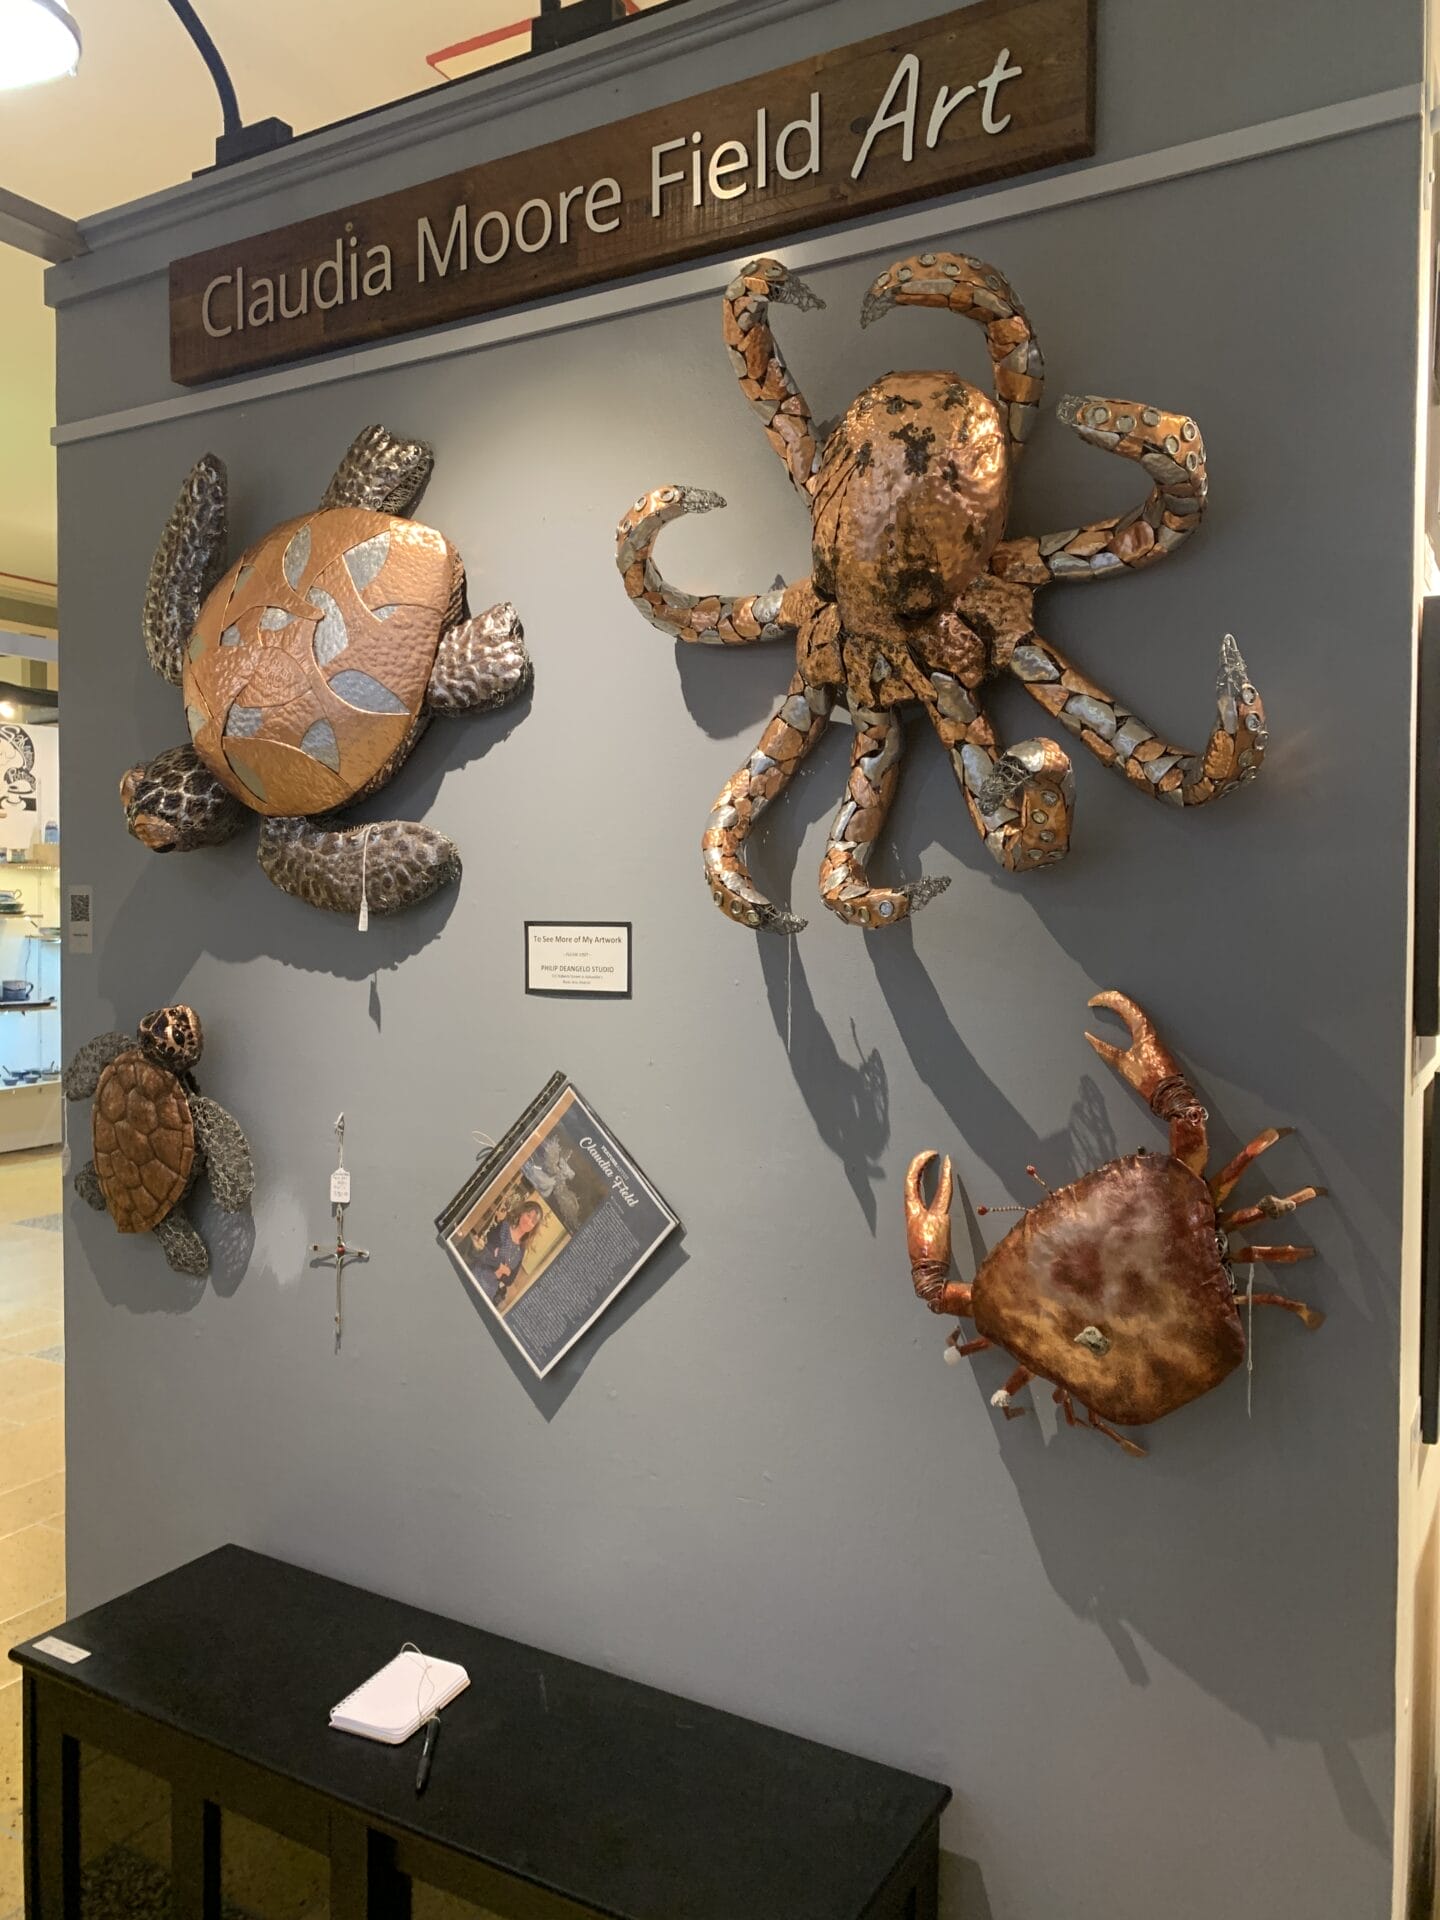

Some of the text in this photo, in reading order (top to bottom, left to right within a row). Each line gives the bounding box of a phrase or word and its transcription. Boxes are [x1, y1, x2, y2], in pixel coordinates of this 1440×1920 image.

[201, 47, 1023, 338] Claudia Moore Field Art
[582, 936, 593, 944] My
[594, 936, 622, 944] Artwork
[560, 965, 590, 973] DEANGELO
[579, 1136, 614, 1178] Claudia
[611, 1175, 640, 1208] Field
